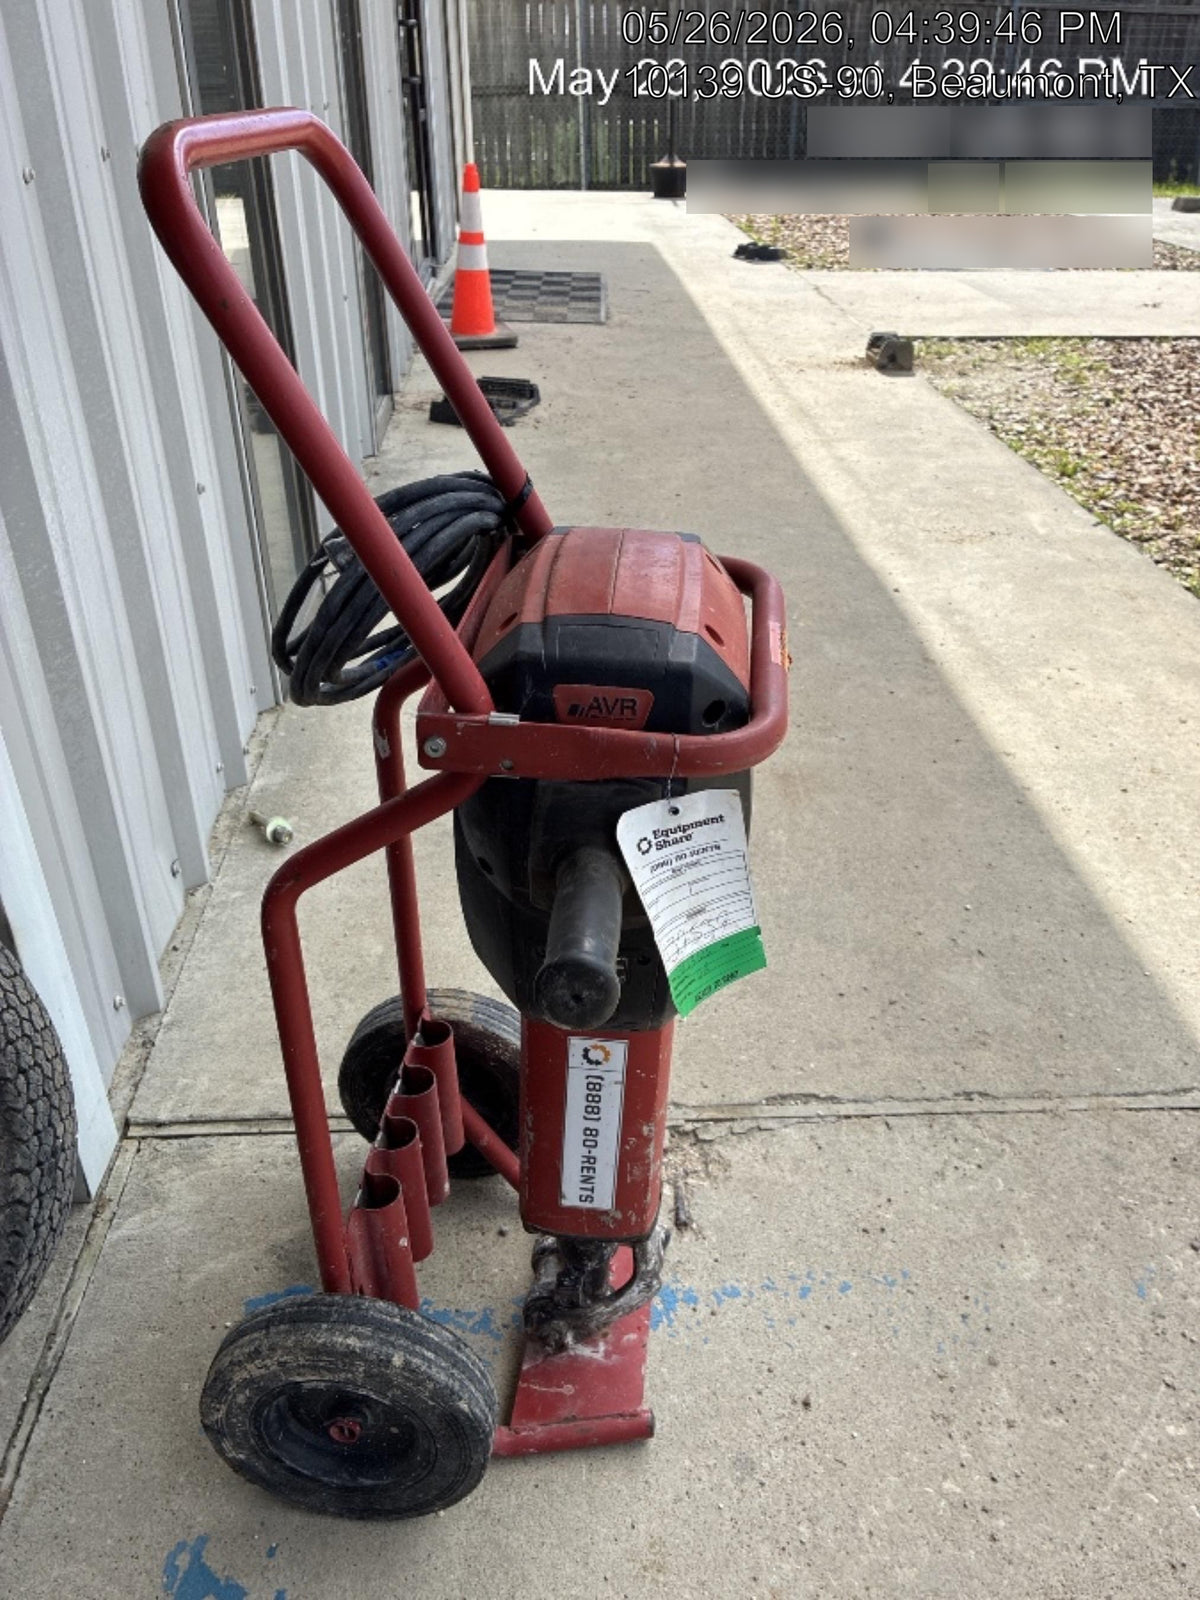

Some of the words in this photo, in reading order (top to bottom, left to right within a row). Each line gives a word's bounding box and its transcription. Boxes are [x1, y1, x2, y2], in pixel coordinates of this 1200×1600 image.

[587, 696, 638, 717] AVR
[651, 814, 725, 842] Equipment
[654, 832, 693, 852] Share
[582, 1074, 605, 1122] (888)
[578, 1126, 600, 1204] 80-RENTS
